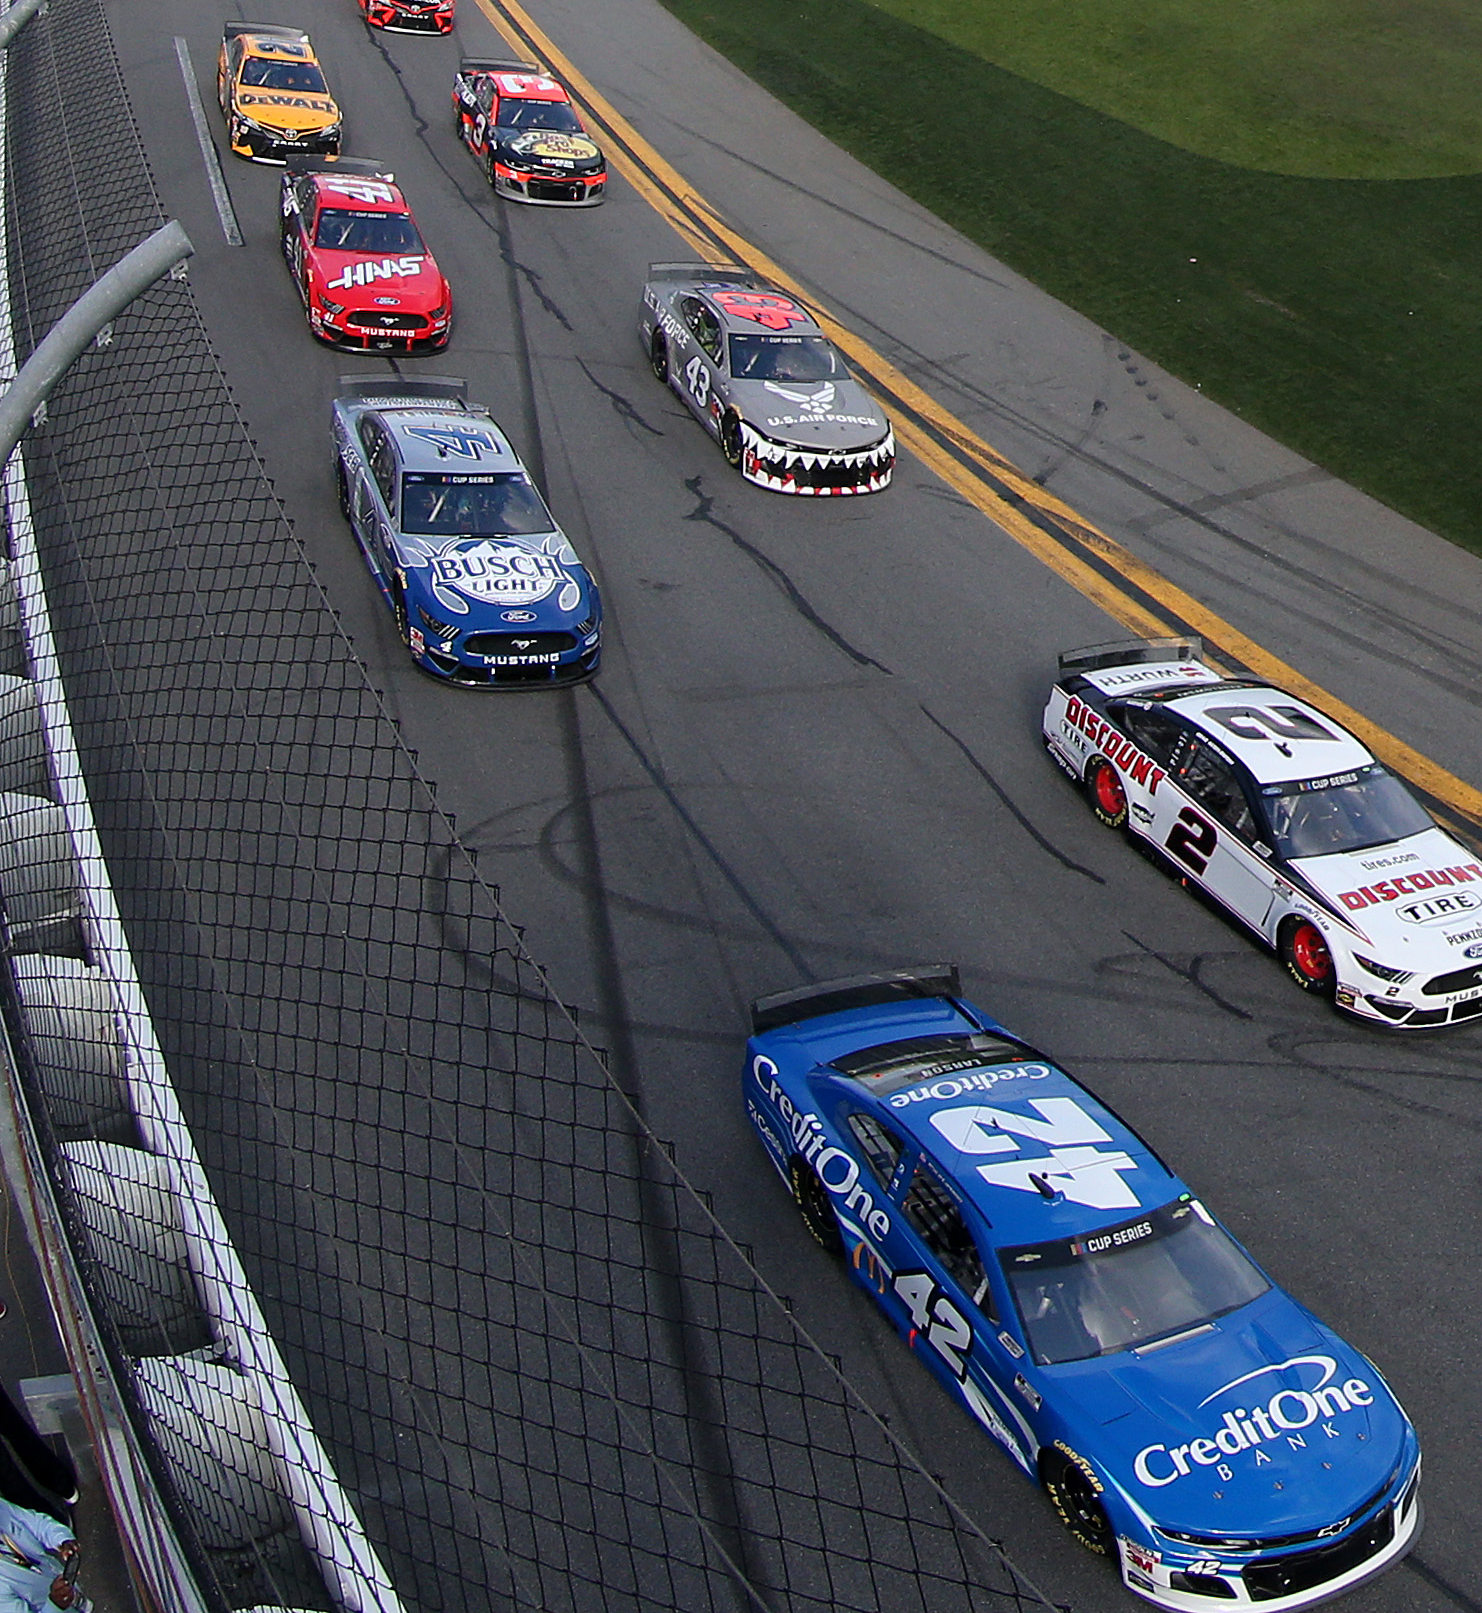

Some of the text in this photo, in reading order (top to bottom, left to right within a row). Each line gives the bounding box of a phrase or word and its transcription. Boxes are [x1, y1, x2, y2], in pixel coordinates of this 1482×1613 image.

[500, 74, 555, 94] 3
[240, 95, 337, 115] DeWALT
[473, 113, 487, 148] 3
[545, 144, 592, 158] Shops
[325, 178, 394, 203] 41
[327, 256, 424, 289] HAAS
[712, 291, 806, 332] 43
[360, 327, 416, 337] MUSTANG
[660, 314, 690, 349] FORCE
[685, 355, 711, 408] 43
[767, 414, 878, 426] U.S. AIR FORCE
[403, 423, 502, 461] 4
[452, 476, 494, 484] CUP SERIES
[436, 555, 562, 581] BUSCH
[471, 579, 544, 593] LIGHT
[439, 641, 453, 653] 4
[483, 653, 560, 665] MUSTANG
[1061, 723, 1088, 754] TIRE
[1201, 705, 1341, 742] 2
[1065, 695, 1167, 796] DISCOUNT
[1312, 773, 1359, 790] CUP SERIES
[1165, 806, 1218, 876] 2
[1360, 852, 1420, 871] tires.com
[1402, 892, 1475, 923] TIRE
[1384, 986, 1400, 997] 2
[920, 1057, 983, 1078] LARSON
[889, 1064, 1051, 1108] CreditOne
[753, 1053, 891, 1244] CreditOne
[928, 1096, 1142, 1211] 42
[1087, 1221, 1153, 1254] CUP SERIES
[893, 1272, 972, 1380] 42
[1132, 1378, 1374, 1488] CreditOne
[1053, 1438, 1105, 1494] GOODYEAR
[1216, 1421, 1340, 1482] BANK
[1186, 1560, 1223, 1576] 42
